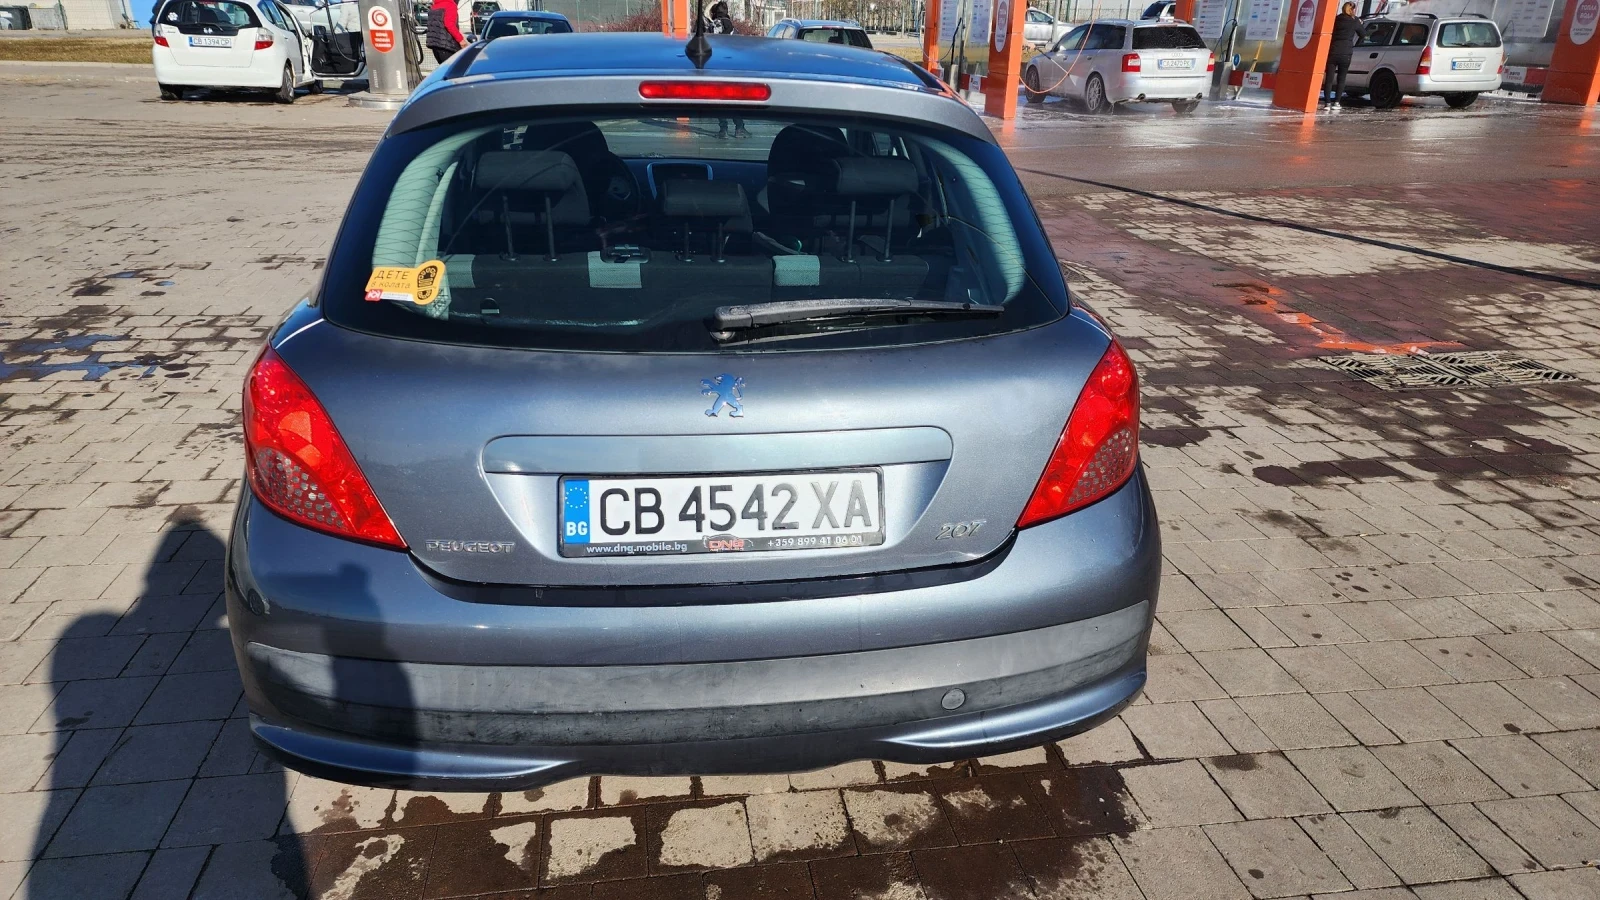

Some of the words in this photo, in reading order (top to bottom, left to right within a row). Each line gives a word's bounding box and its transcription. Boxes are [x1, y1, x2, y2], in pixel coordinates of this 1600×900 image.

[204, 37, 220, 46] 1394
[374, 270, 410, 280] ДЕТЕ
[600, 487, 665, 536] CB
[679, 482, 800, 533] 4542
[809, 479, 872, 529] XA
[566, 521, 588, 536] BG
[935, 519, 987, 540] 207
[425, 539, 515, 554] PEUGEOT
[708, 539, 745, 549] DNG
[767, 538, 793, 547] +359
[797, 537, 816, 546] 899
[819, 535, 832, 545] 41
[835, 535, 847, 544] 06
[586, 542, 688, 554] www.dng.mobile.bg
